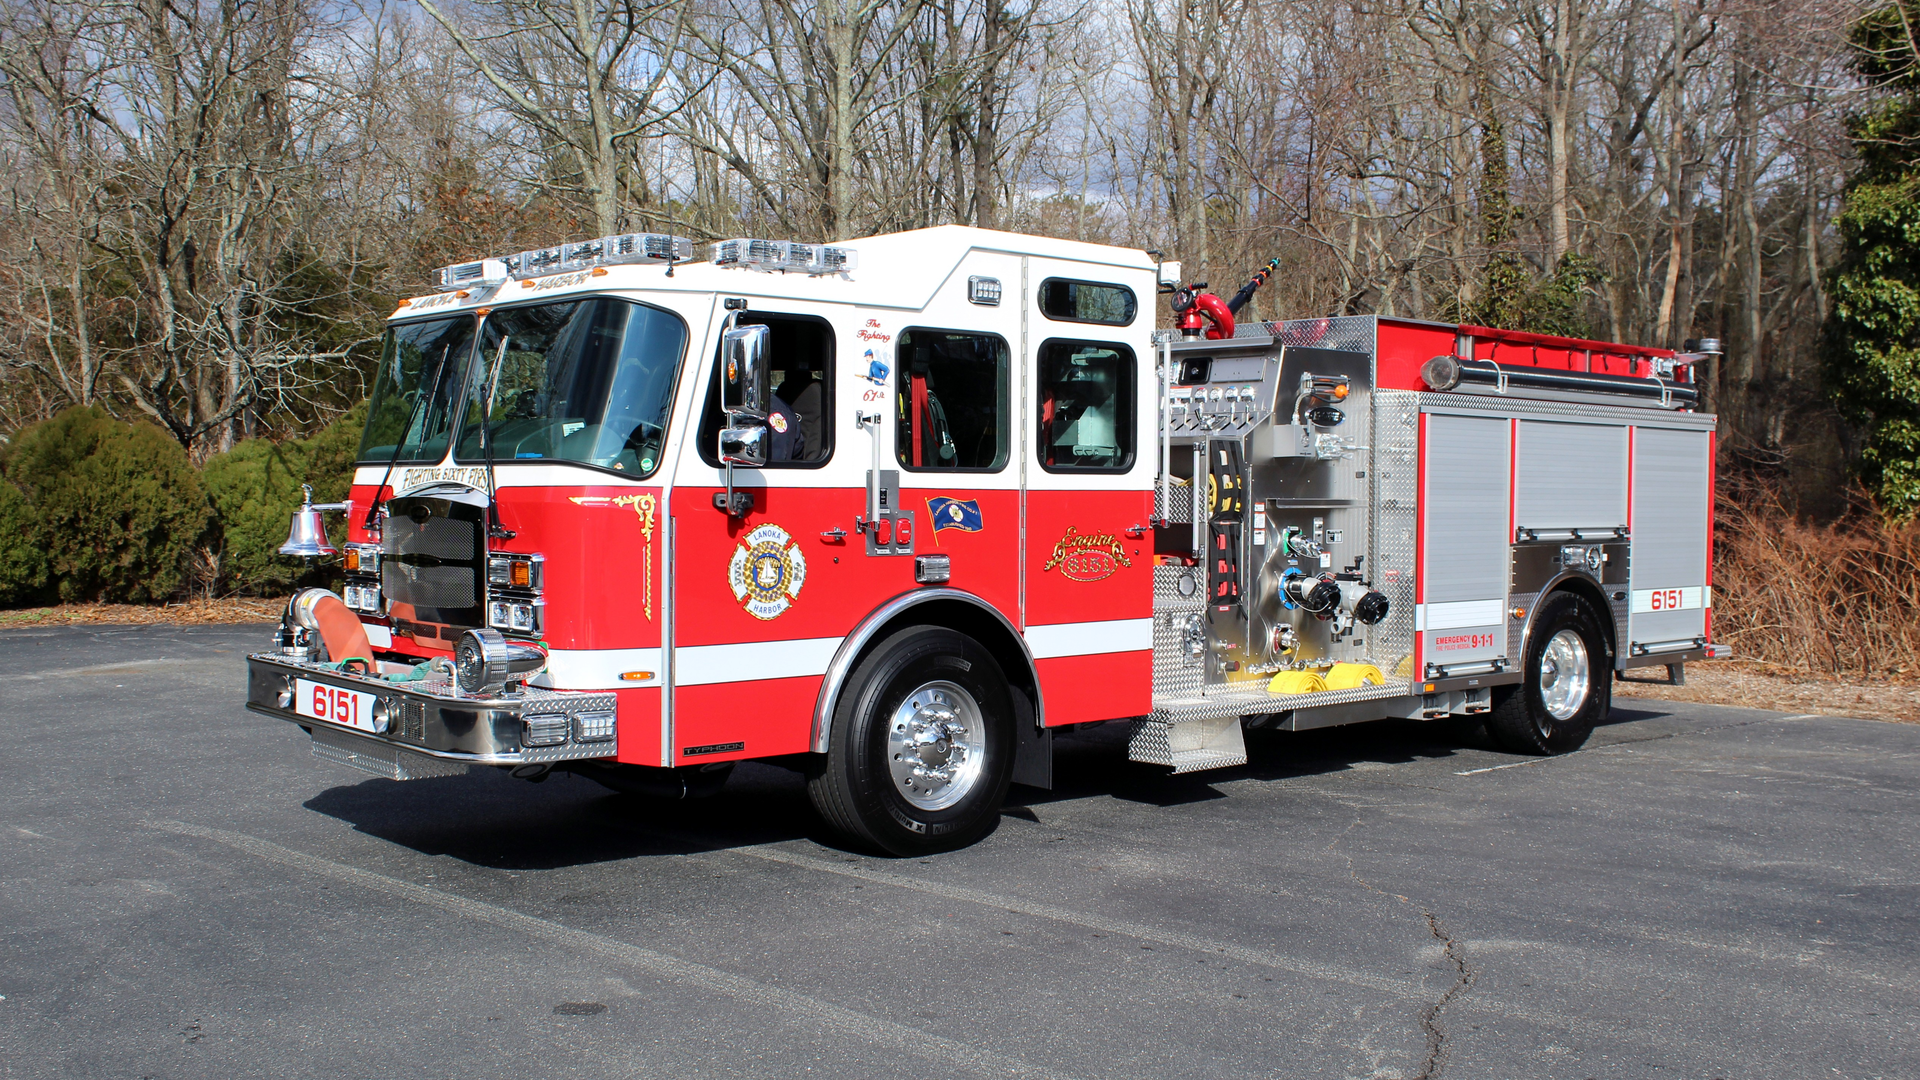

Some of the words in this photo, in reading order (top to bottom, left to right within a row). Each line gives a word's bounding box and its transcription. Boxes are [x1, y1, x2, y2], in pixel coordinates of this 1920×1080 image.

[532, 271, 591, 291] HARBOR
[866, 319, 881, 328] The
[857, 330, 890, 343] Fighting
[403, 468, 441, 489] FIGHTING
[442, 468, 468, 480] SIXTY
[468, 468, 489, 490] FIRS
[753, 530, 780, 540] LANOKA
[1061, 526, 1115, 555] Engine
[1068, 557, 1110, 573] 6151
[1652, 590, 1682, 610] 6151
[754, 604, 782, 614] HARBOR
[1436, 635, 1471, 645] EMERGENCY
[313, 685, 358, 725] 6151
[685, 743, 743, 754] TYPHOON
